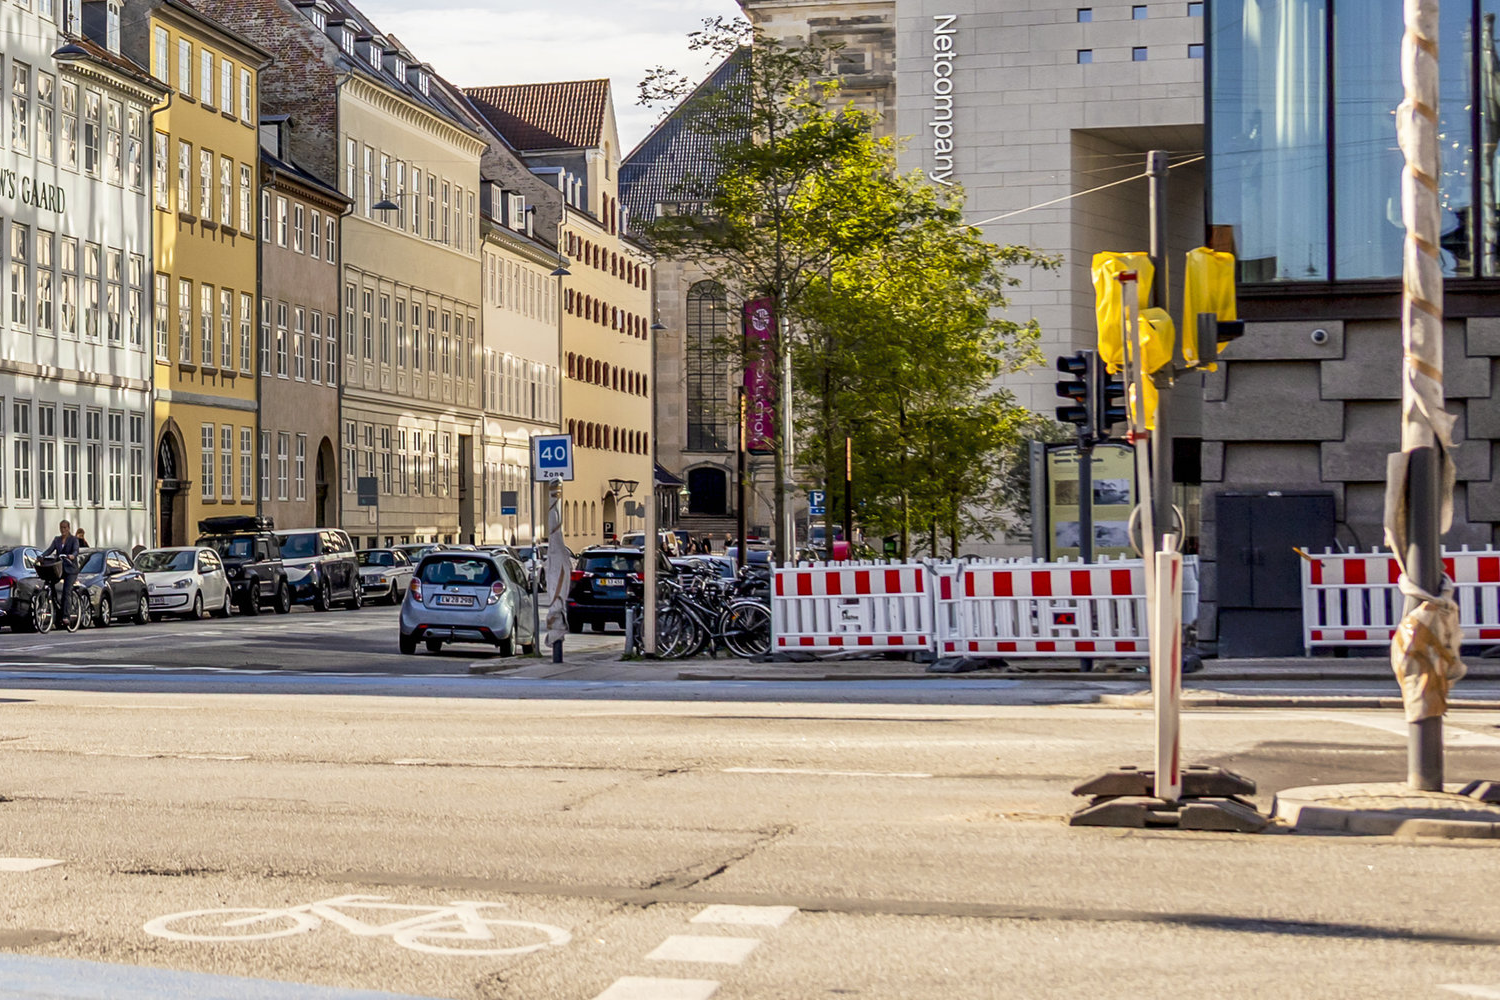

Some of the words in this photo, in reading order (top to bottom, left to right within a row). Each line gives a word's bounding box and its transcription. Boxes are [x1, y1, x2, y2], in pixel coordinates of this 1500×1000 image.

[929, 14, 957, 187] Netcompany
[22, 175, 66, 214] GAARD
[540, 445, 566, 461] 40
[543, 470, 565, 478] Zone
